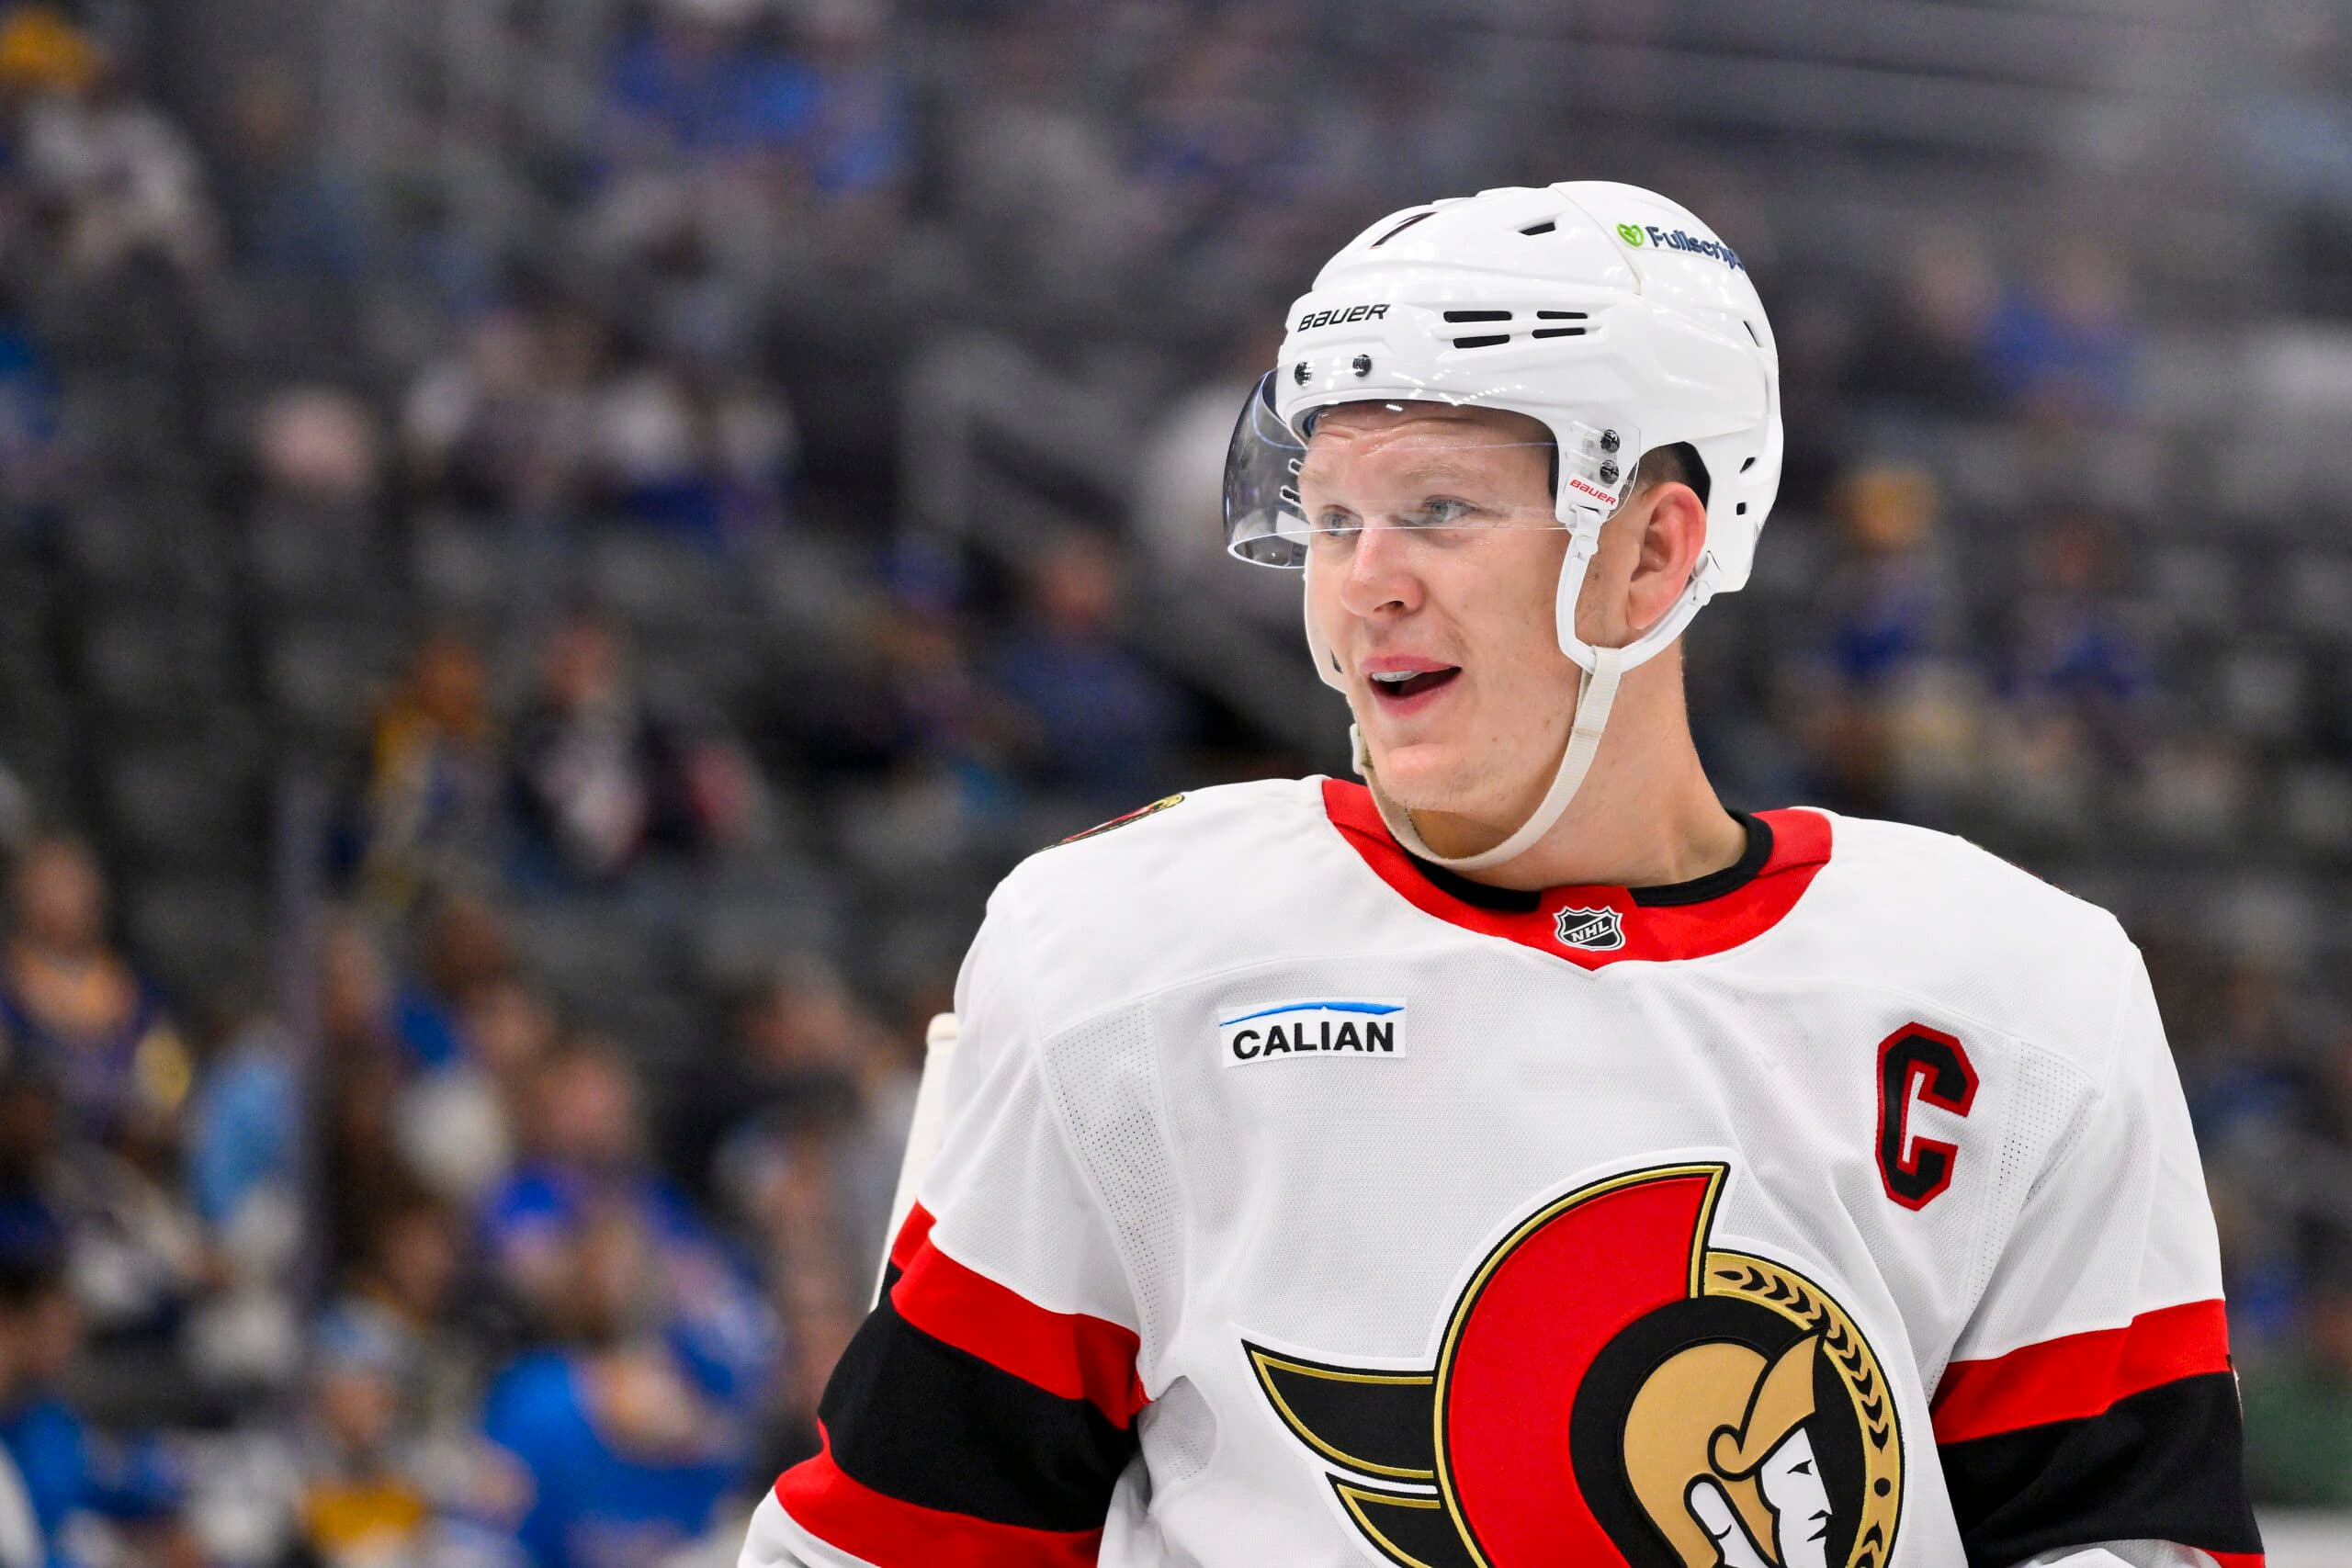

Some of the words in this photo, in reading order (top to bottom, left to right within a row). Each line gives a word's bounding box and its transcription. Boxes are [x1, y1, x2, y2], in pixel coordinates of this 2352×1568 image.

[1297, 304, 1391, 333] BAUER
[1569, 479, 1616, 505] BAUER
[1571, 920, 1610, 942] NHL
[1232, 1021, 1394, 1060] CALIAN
[1875, 1021, 1980, 1212] C
